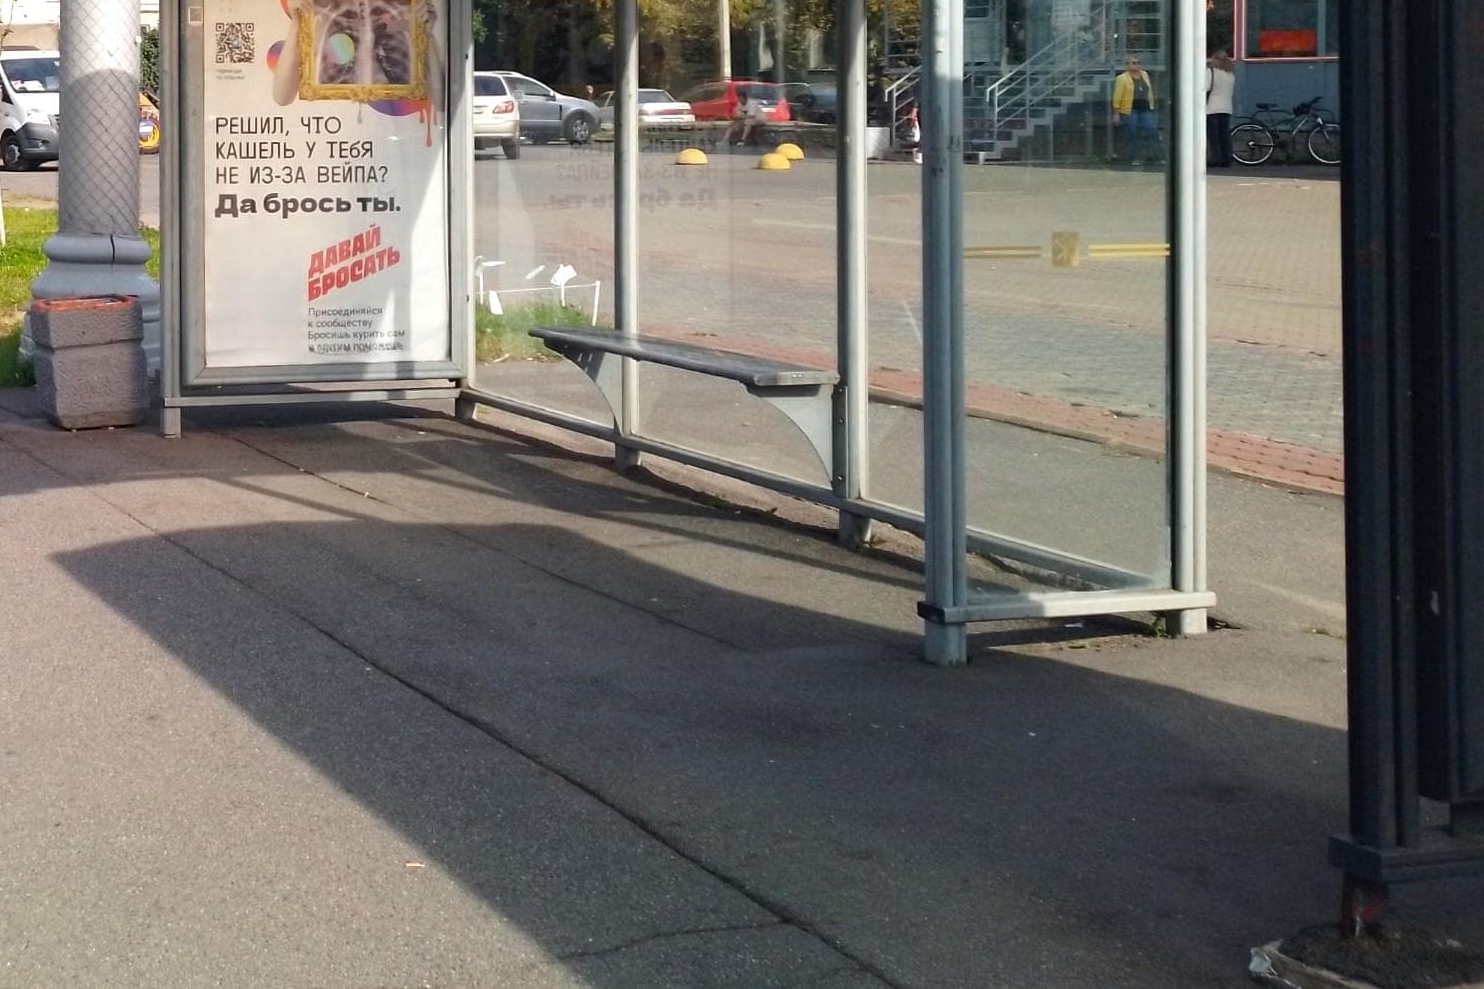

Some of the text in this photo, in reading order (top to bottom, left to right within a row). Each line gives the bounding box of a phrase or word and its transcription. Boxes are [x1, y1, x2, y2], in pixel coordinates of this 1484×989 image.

[215, 116, 342, 136] РЕШИЛ, ЧТО
[215, 141, 296, 160] КАШЕЛЬ
[305, 141, 316, 159] У
[215, 161, 389, 184] НЕ ИЗ-ЗА ВЕЙПА?
[214, 192, 402, 219] Да брось ты.
[308, 223, 381, 279] ДАВАЙ
[308, 245, 401, 302] БРОСАТЬ
[308, 306, 383, 317] Присоединяйся
[316, 318, 373, 329] сообществу
[307, 329, 405, 341] Бросишь курить сам
